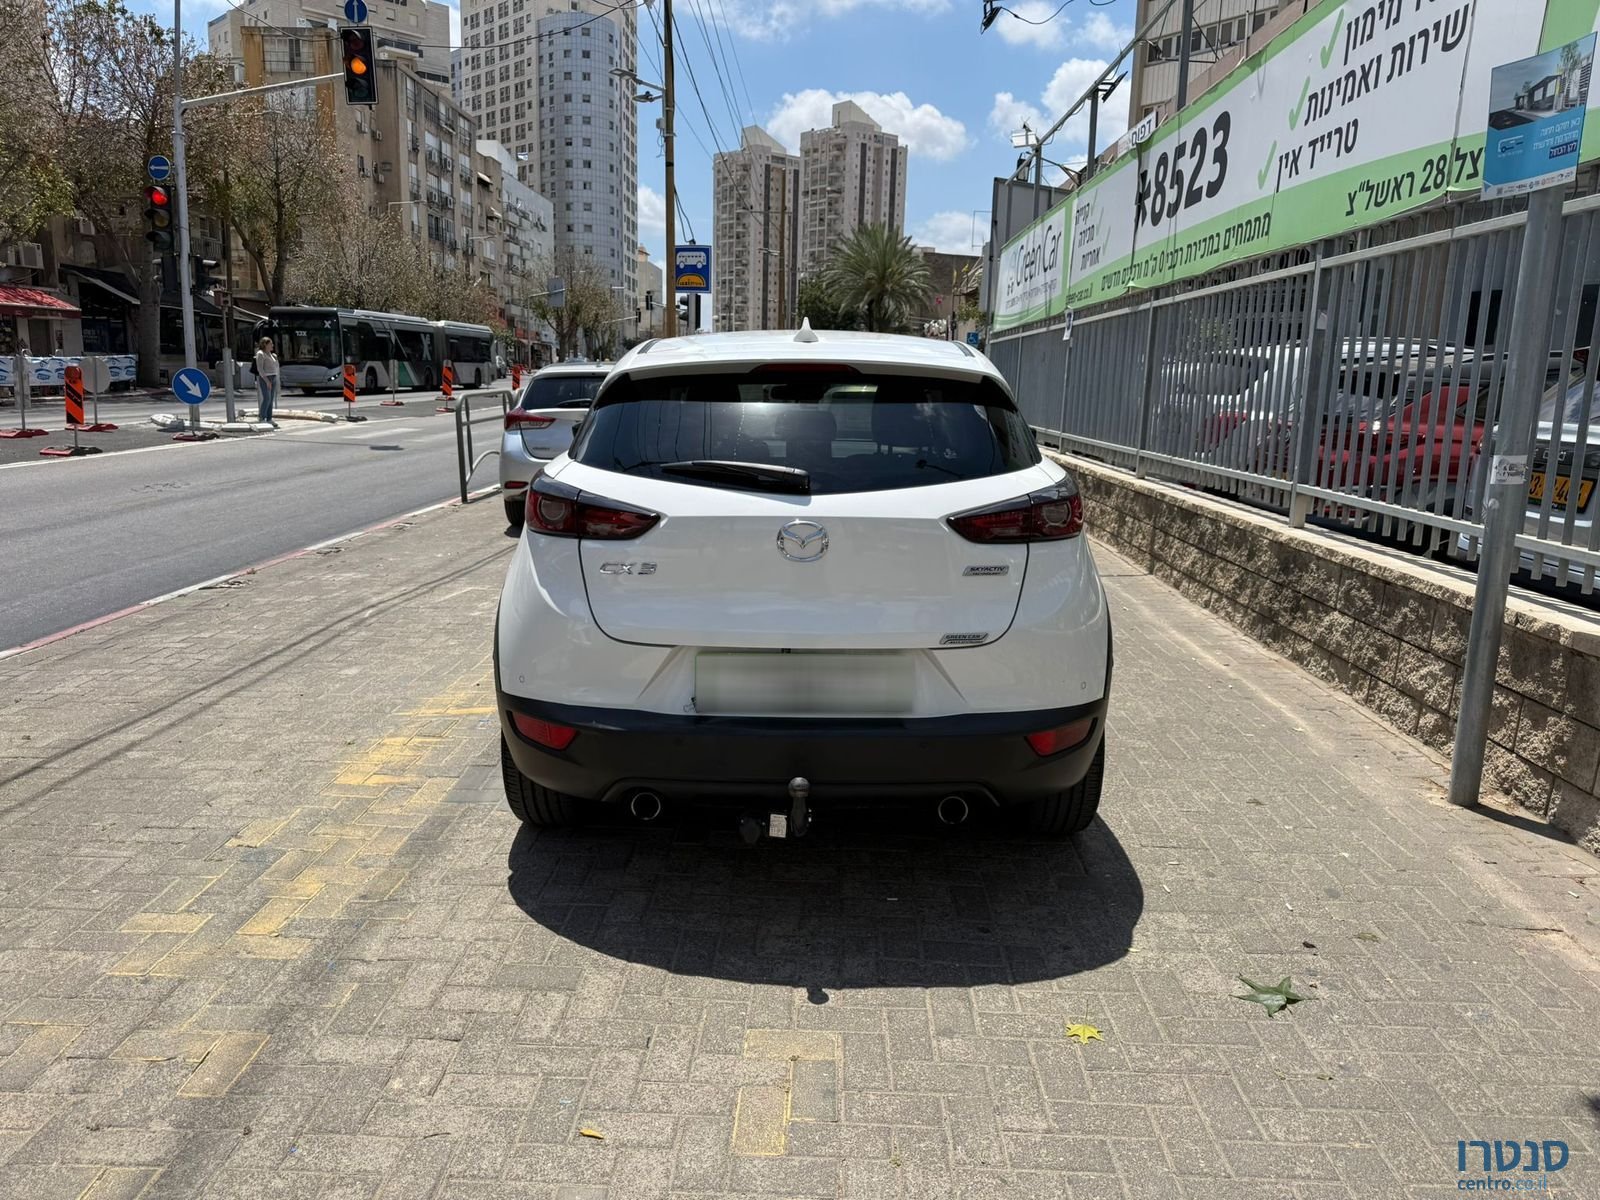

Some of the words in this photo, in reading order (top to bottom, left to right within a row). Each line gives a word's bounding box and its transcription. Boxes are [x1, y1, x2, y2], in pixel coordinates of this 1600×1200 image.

[1387, 3, 1469, 83] שירות
[1304, 53, 1382, 126] ואמינות
[1309, 118, 1359, 169] טרייד
[1276, 143, 1302, 193] אין
[1420, 154, 1447, 194] 28
[1454, 147, 1484, 183] צל
[1185, 233, 1221, 263] במכירת
[1223, 212, 1271, 251] מתמחים
[970, 565, 1006, 573] SKYACTIV
